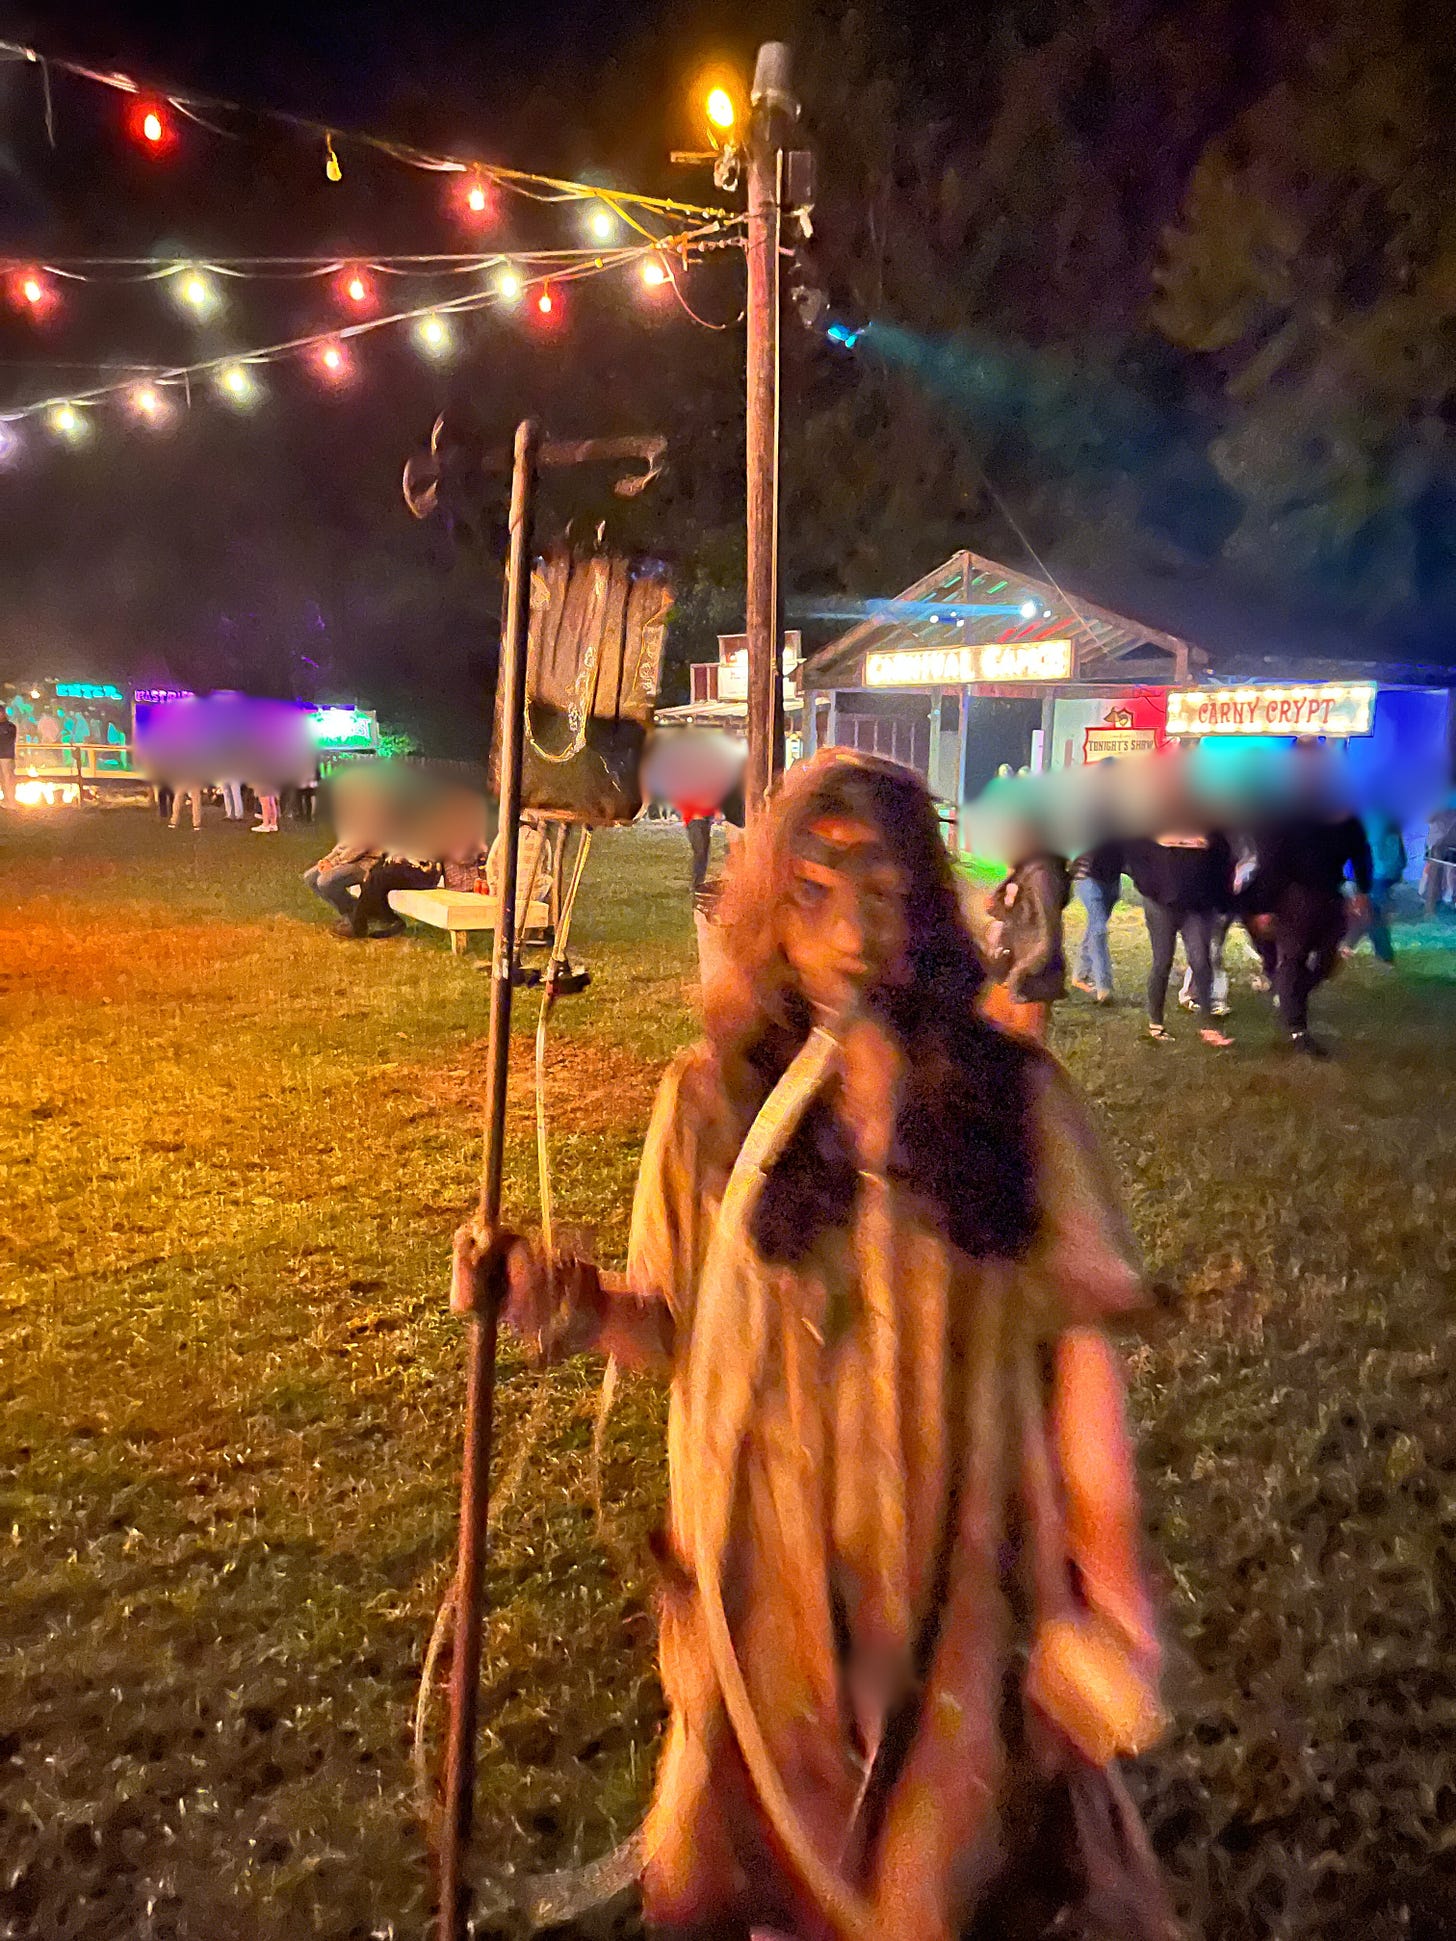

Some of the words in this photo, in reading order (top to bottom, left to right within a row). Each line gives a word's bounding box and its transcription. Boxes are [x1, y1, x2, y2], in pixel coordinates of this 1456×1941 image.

[1198, 697, 1260, 724] CARNY
[1265, 697, 1336, 724] CRYPT
[1089, 740, 1129, 752] TONIGHT'S
[1131, 740, 1154, 751] SHOW
